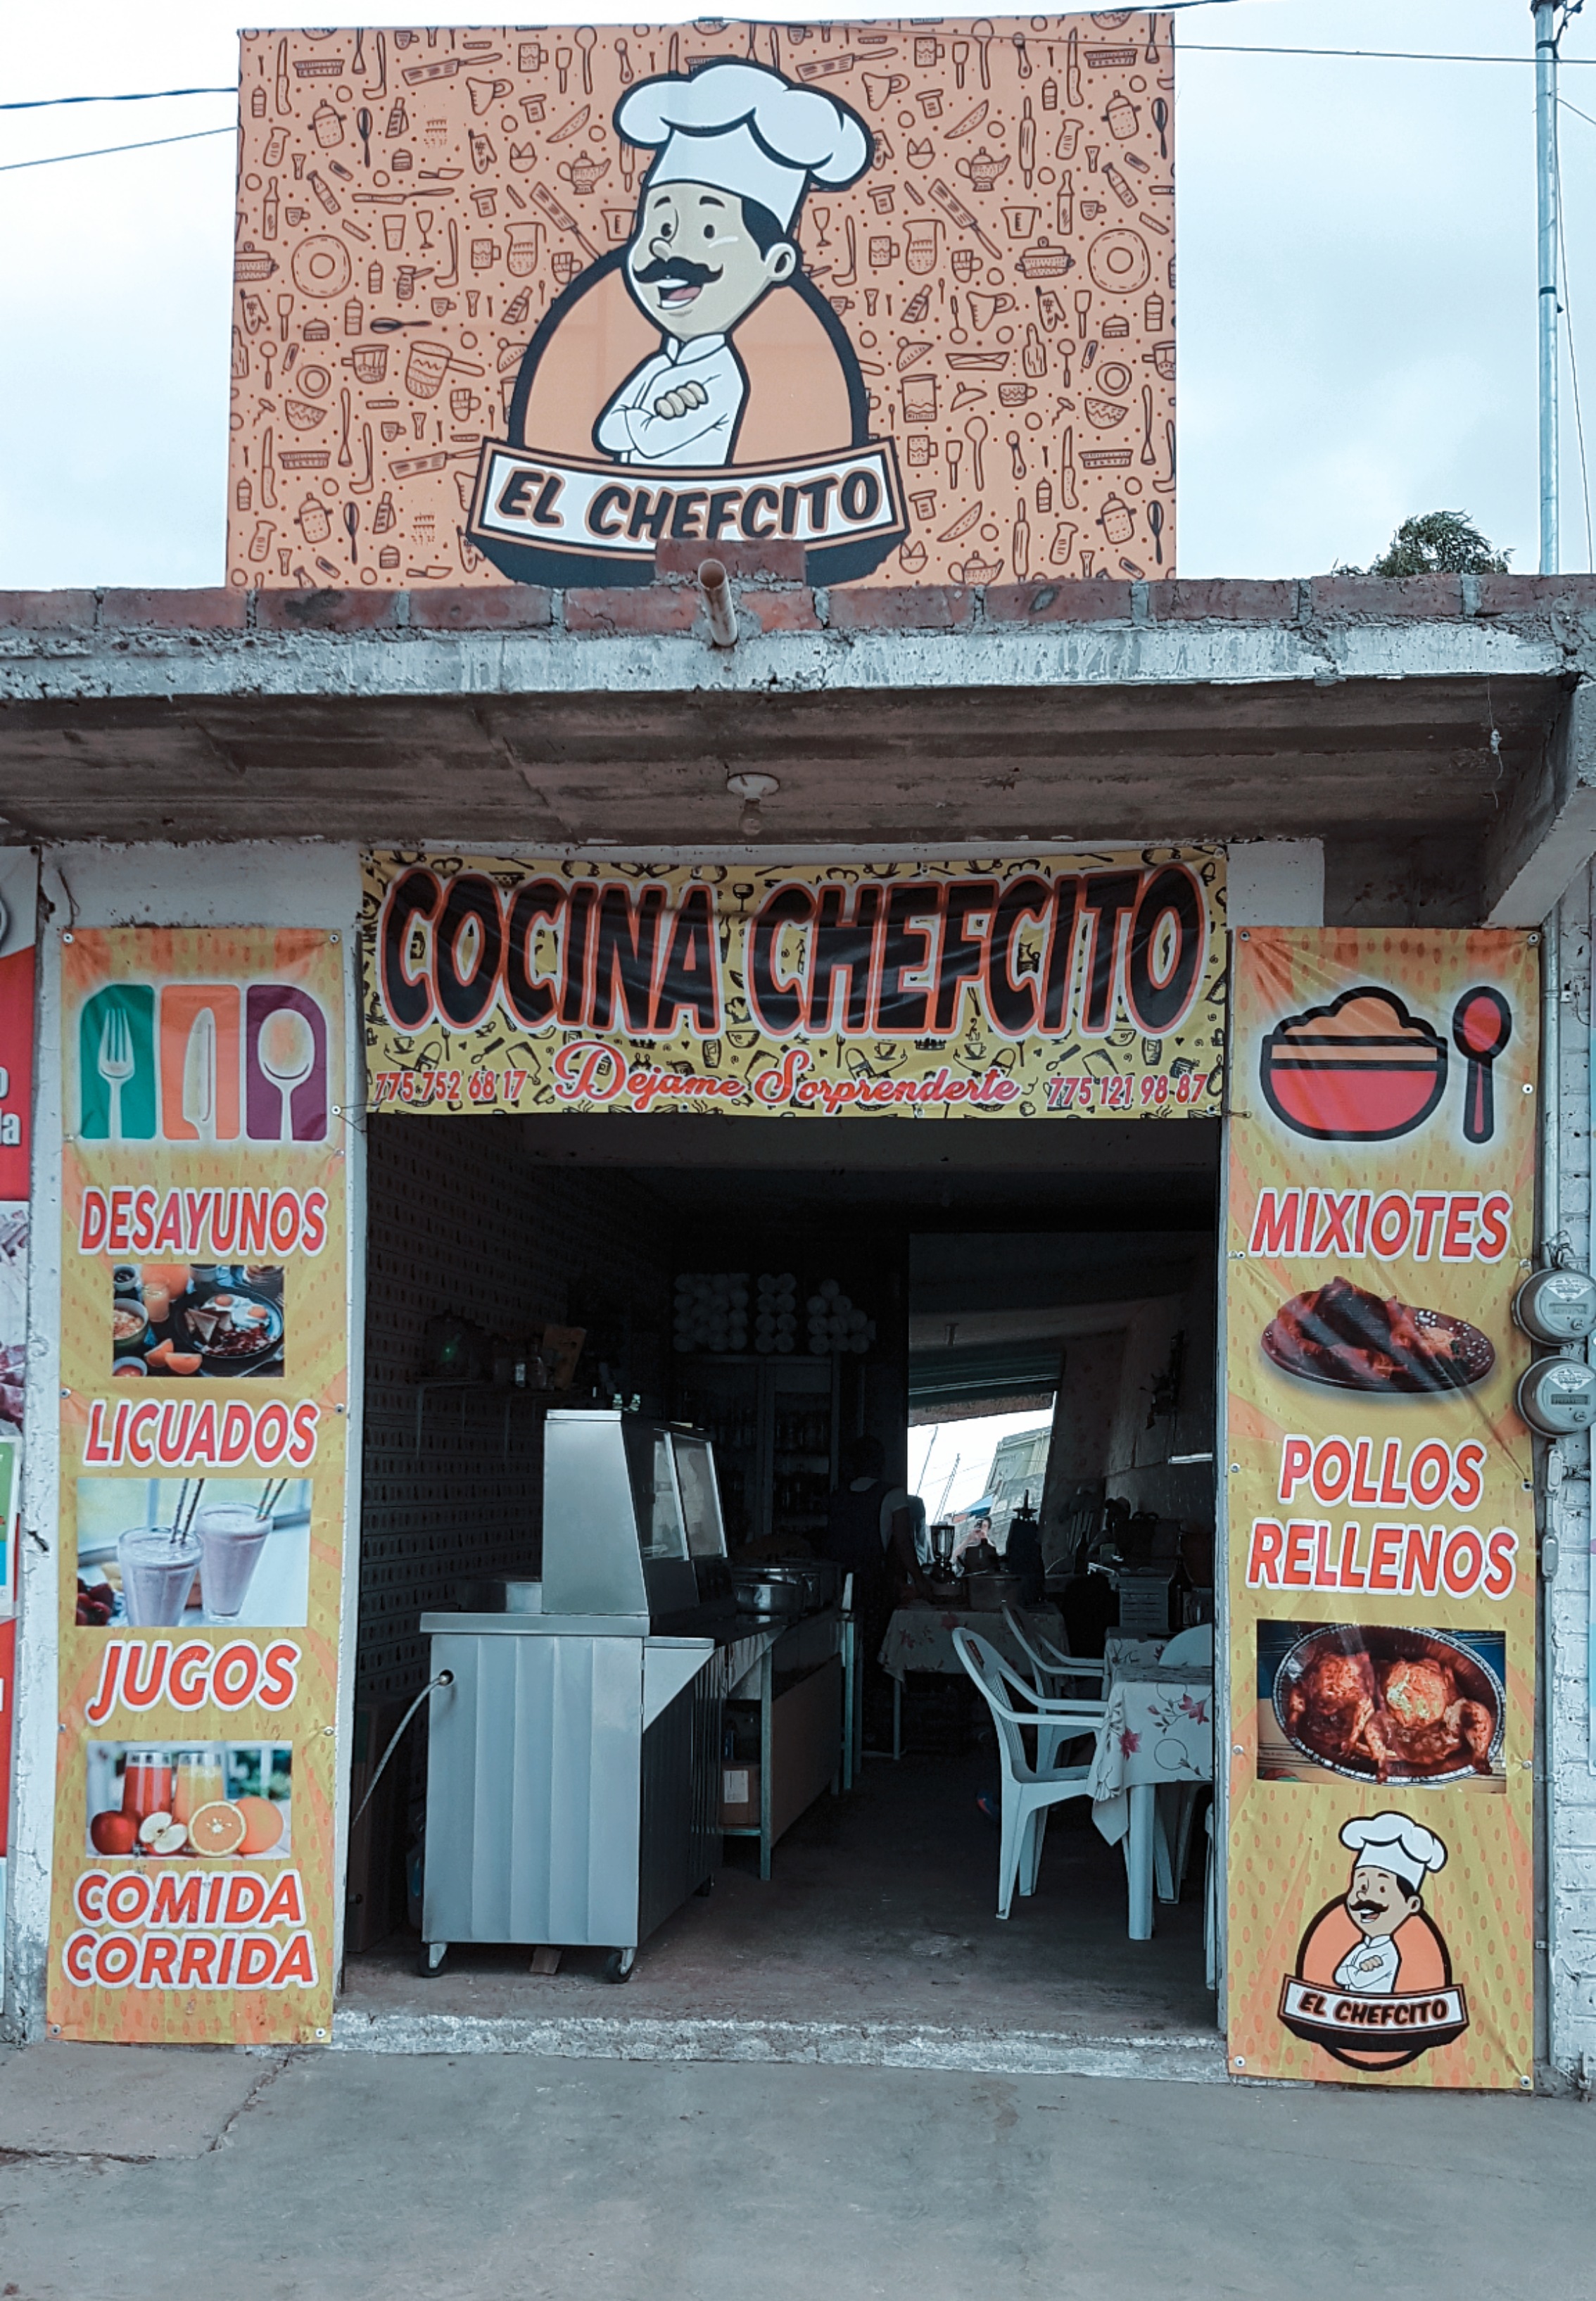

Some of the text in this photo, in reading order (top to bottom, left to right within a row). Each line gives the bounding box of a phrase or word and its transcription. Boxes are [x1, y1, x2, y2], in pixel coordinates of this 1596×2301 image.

[495, 467, 882, 541] EL CHEFCITO
[380, 862, 1208, 1039] COCINA CHEFCITO
[374, 1069, 528, 1102] 775 752 68 17
[552, 1040, 1021, 1114] Dejame Sorprenderte
[1048, 1073, 1209, 1106] 775 121 98 87
[79, 1186, 328, 1256] DESAYUNOS
[1249, 1189, 1512, 1262] MIXIOTES
[84, 1399, 320, 1468] LICUADOS
[1278, 1435, 1486, 1511] POLLOS
[1246, 1518, 1519, 1599] RELLENOS
[85, 1639, 301, 1726] JUGOS
[73, 1869, 305, 1930] COMIDA
[62, 1931, 319, 1991] CORRIDA
[1298, 1991, 1448, 2026] EL CHEFCITO
